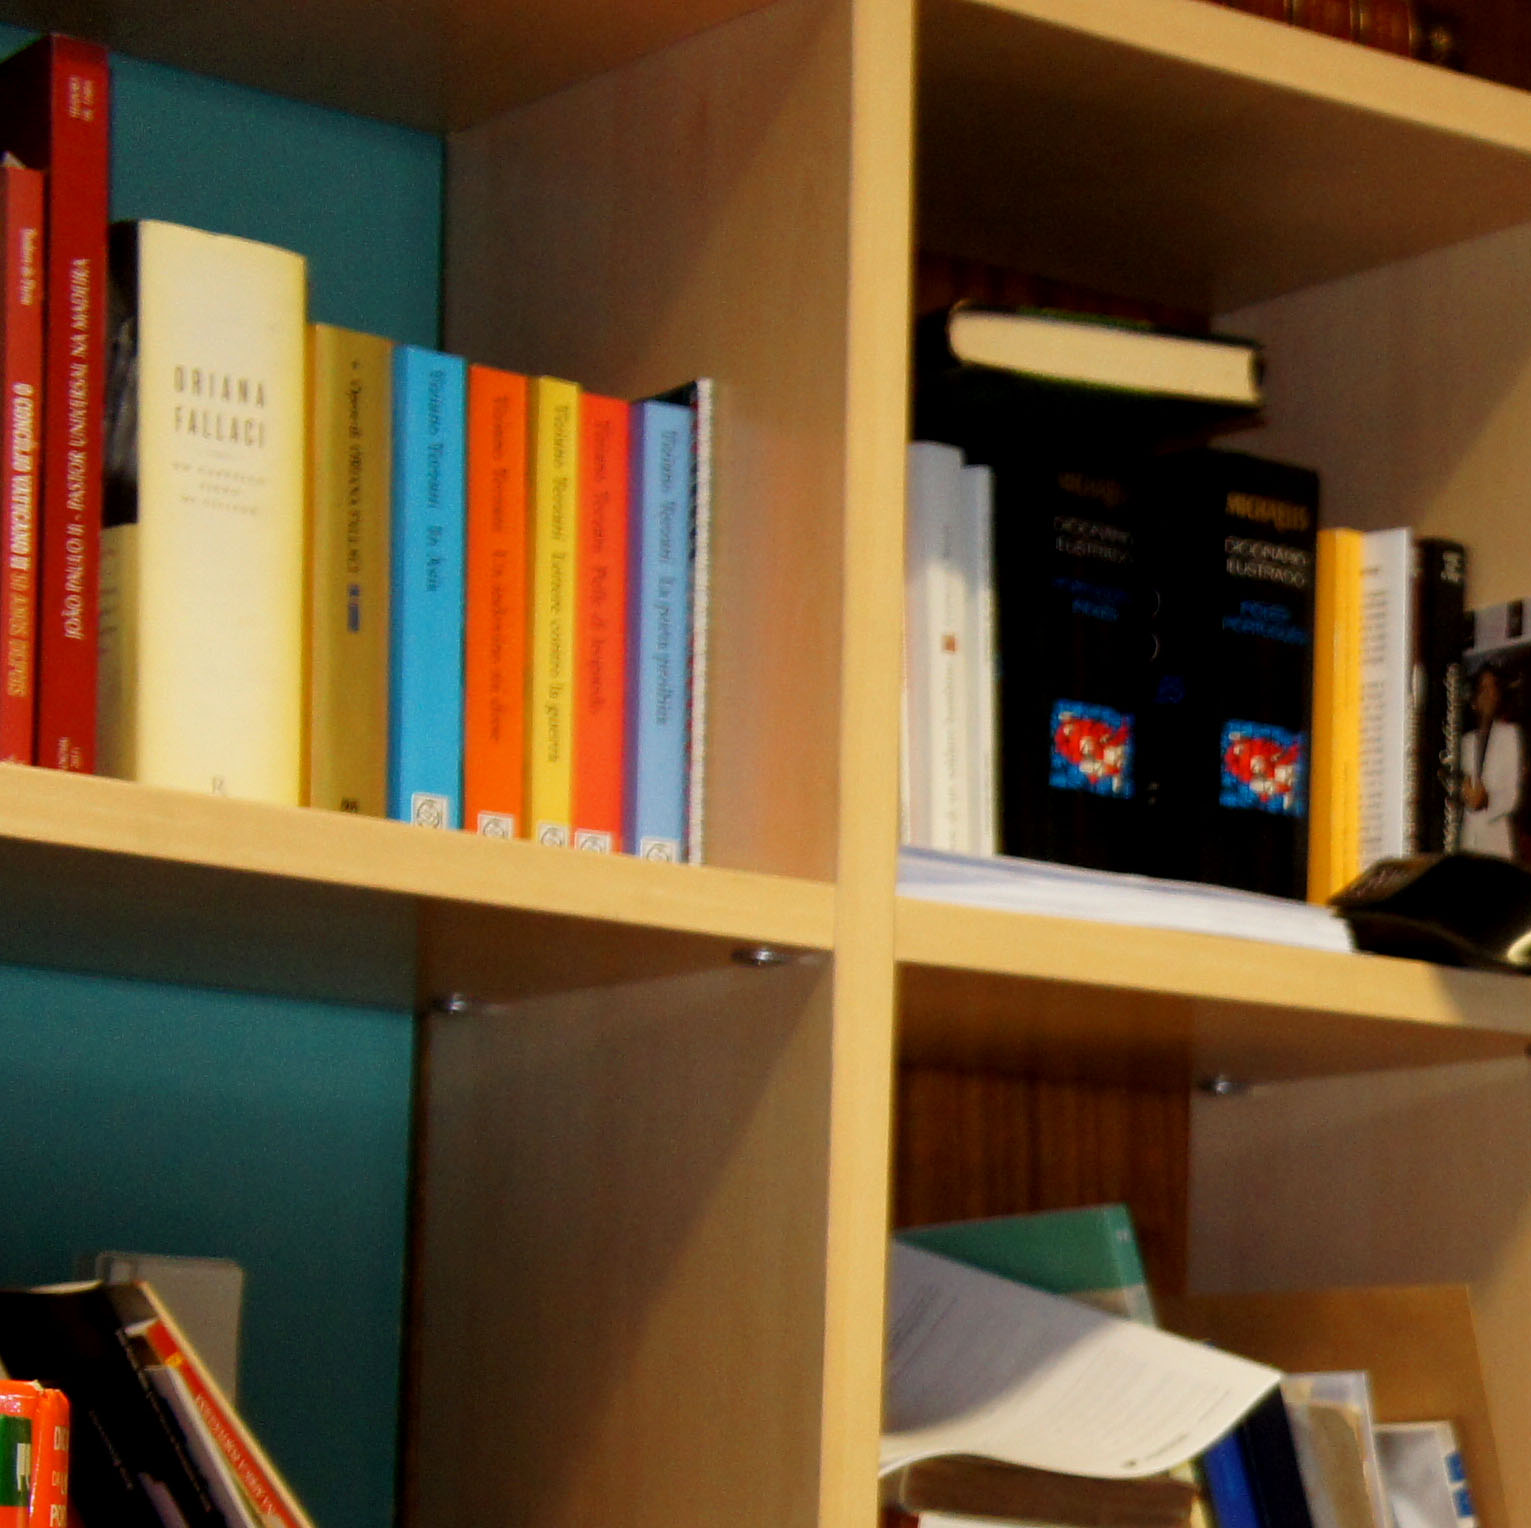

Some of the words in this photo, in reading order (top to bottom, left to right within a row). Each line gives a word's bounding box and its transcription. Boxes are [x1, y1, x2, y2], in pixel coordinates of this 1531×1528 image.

[70, 258, 92, 332] MADEIRA
[69, 334, 90, 358] NA
[67, 363, 89, 448] UNIVERSAL
[173, 364, 265, 408] ORIANA
[173, 405, 265, 449] FALLACI
[553, 404, 571, 469] Tiziano
[64, 450, 86, 511] PASTOR
[427, 442, 444, 508] Terzani
[660, 430, 678, 491] Tiziano
[10, 474, 33, 555] VATICANO
[551, 476, 569, 541] Terzani
[659, 500, 677, 564] Terzani
[64, 539, 85, 593] PAULO
[550, 551, 567, 613] Lettere
[61, 594, 87, 640] JOÃO
[549, 619, 564, 679] contro
[546, 703, 565, 764] guerra
